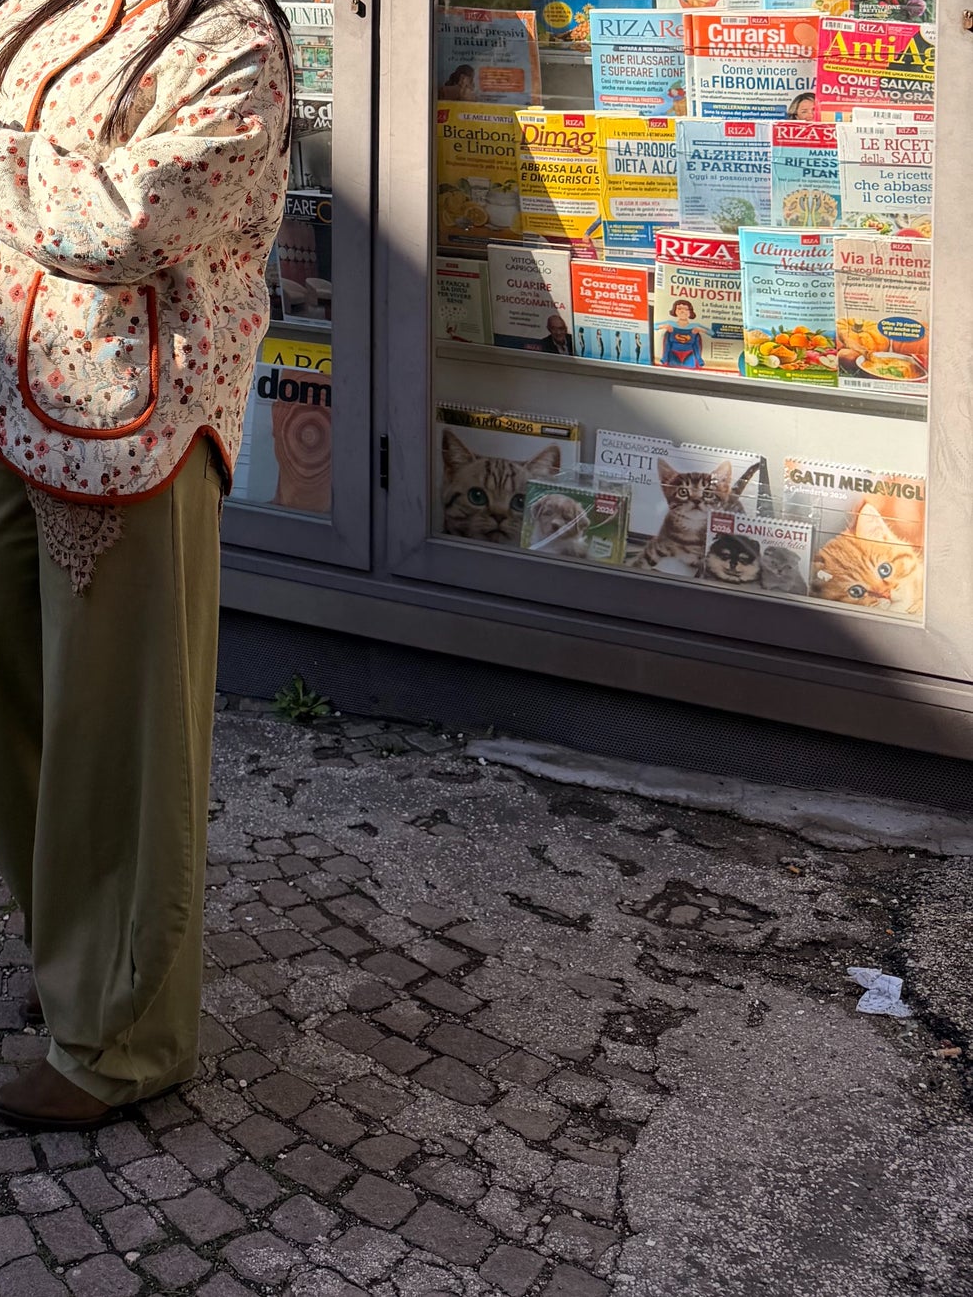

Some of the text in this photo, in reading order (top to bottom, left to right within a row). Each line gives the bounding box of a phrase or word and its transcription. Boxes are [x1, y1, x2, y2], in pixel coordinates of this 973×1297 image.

[708, 24, 785, 43] Curarsi
[859, 24, 884, 33] RIZA
[454, 37, 507, 48] naturali
[709, 43, 812, 57] MANGIANDO
[600, 54, 676, 66] COME RILASSARE
[601, 66, 653, 77] E SUPERARE
[722, 64, 798, 76] Come vincere
[700, 78, 709, 88] la
[838, 74, 877, 86] COME
[822, 84, 901, 99] DAL FEGATO
[473, 114, 492, 122] MILLE
[520, 124, 596, 156] Dimag
[861, 139, 880, 151] LE
[454, 143, 462, 152] e
[617, 141, 631, 156] LA
[861, 154, 884, 164] della
[520, 163, 568, 174] ABBASSA
[570, 164, 582, 174] LA
[615, 158, 647, 173] DIETA
[686, 162, 697, 171] E
[521, 172, 591, 184] E DIMAGRISCI
[689, 174, 709, 183] Oggi
[720, 175, 752, 183] possono
[880, 170, 893, 179] Le
[854, 181, 883, 190] che
[863, 192, 872, 202] il
[511, 257, 545, 266] VITTORIO
[840, 252, 885, 266] Via la
[507, 278, 552, 291] GUARIRE
[582, 278, 638, 292] Correggi
[670, 274, 702, 286] COME
[752, 276, 774, 286] Con
[777, 278, 800, 288] Orzo
[580, 287, 642, 302] la postura
[756, 287, 817, 298] salvi arterie
[496, 295, 566, 310] PSICOSOMATICA
[258, 369, 331, 407] dom
[505, 420, 533, 432] 2026
[602, 438, 669, 455] CALENDARIO 2026
[601, 450, 652, 470] GATTI
[790, 469, 835, 488] GATTI
[736, 523, 808, 542] CANI&GATTI
